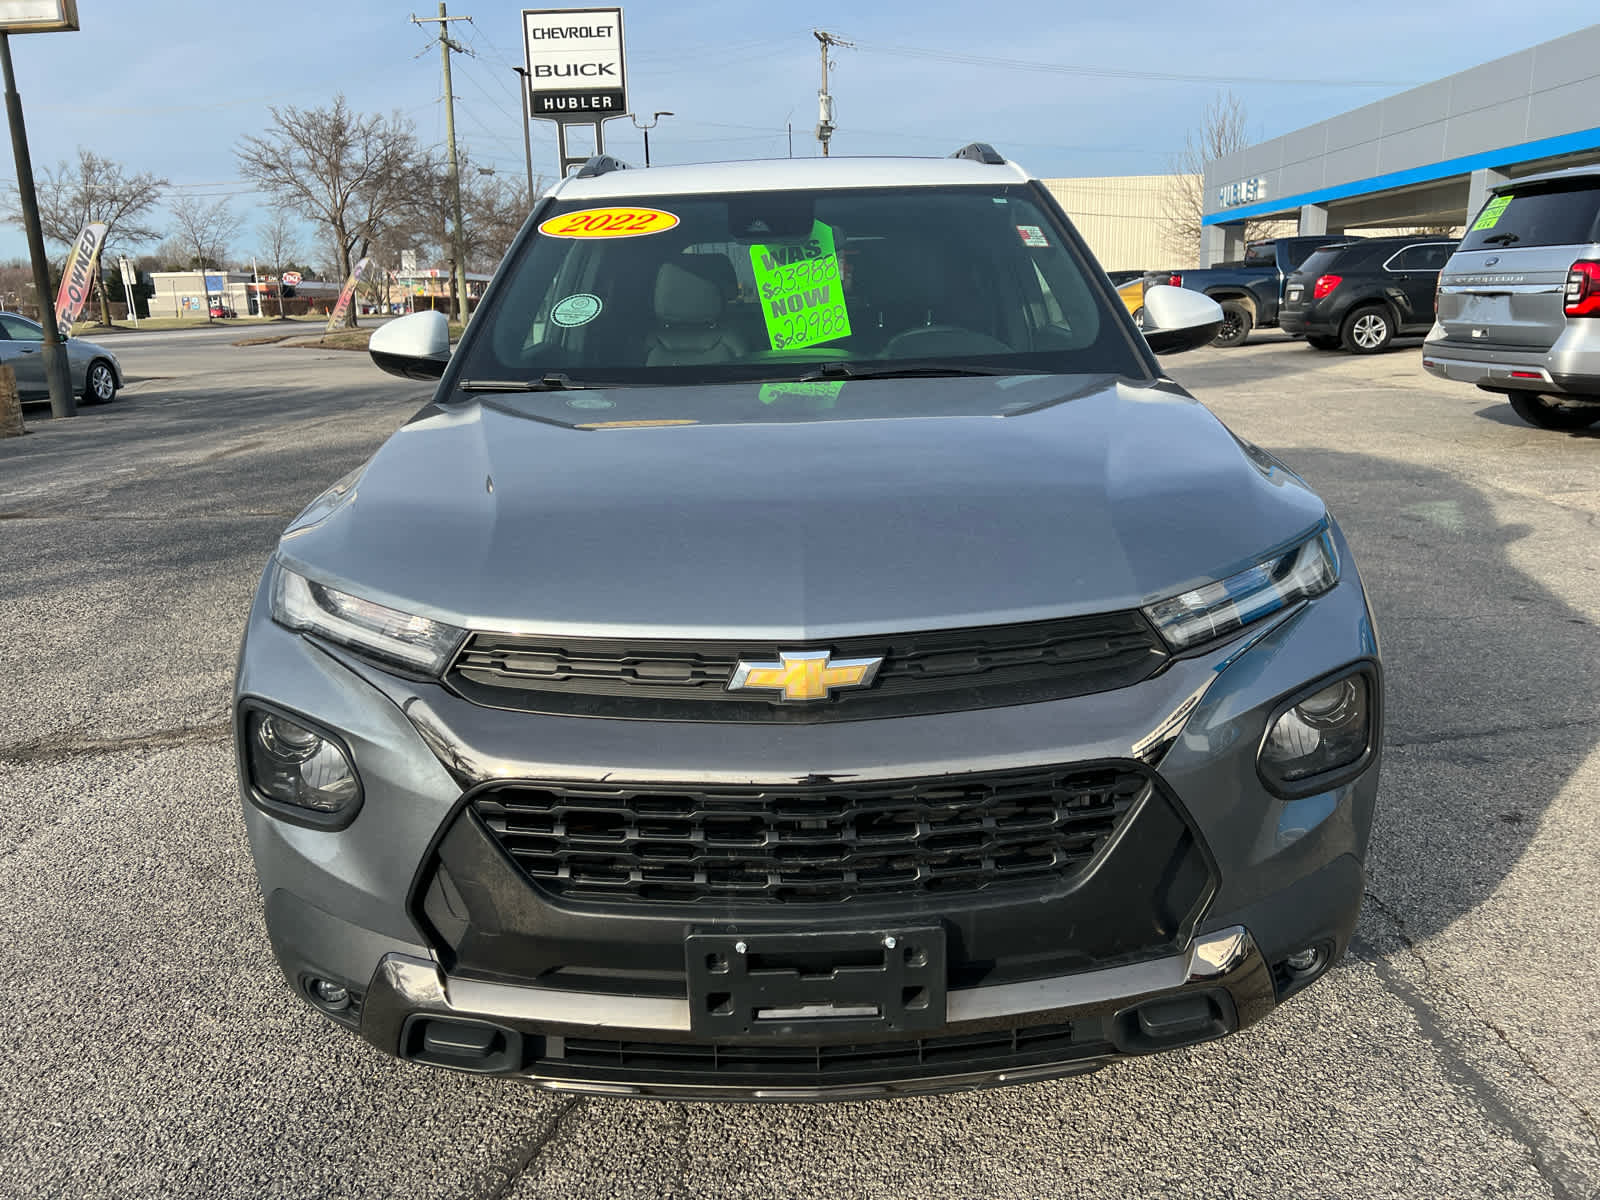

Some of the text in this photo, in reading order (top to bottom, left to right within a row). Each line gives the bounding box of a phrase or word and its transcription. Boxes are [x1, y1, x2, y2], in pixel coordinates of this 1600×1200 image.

[532, 25, 613, 40] CHEVROLET
[534, 62, 616, 77] BUICK
[543, 96, 612, 110] HUBLER
[558, 213, 658, 233] 2022
[761, 239, 822, 272] WAS
[59, 229, 95, 334] RE-OWNED
[770, 285, 830, 319] NOW
